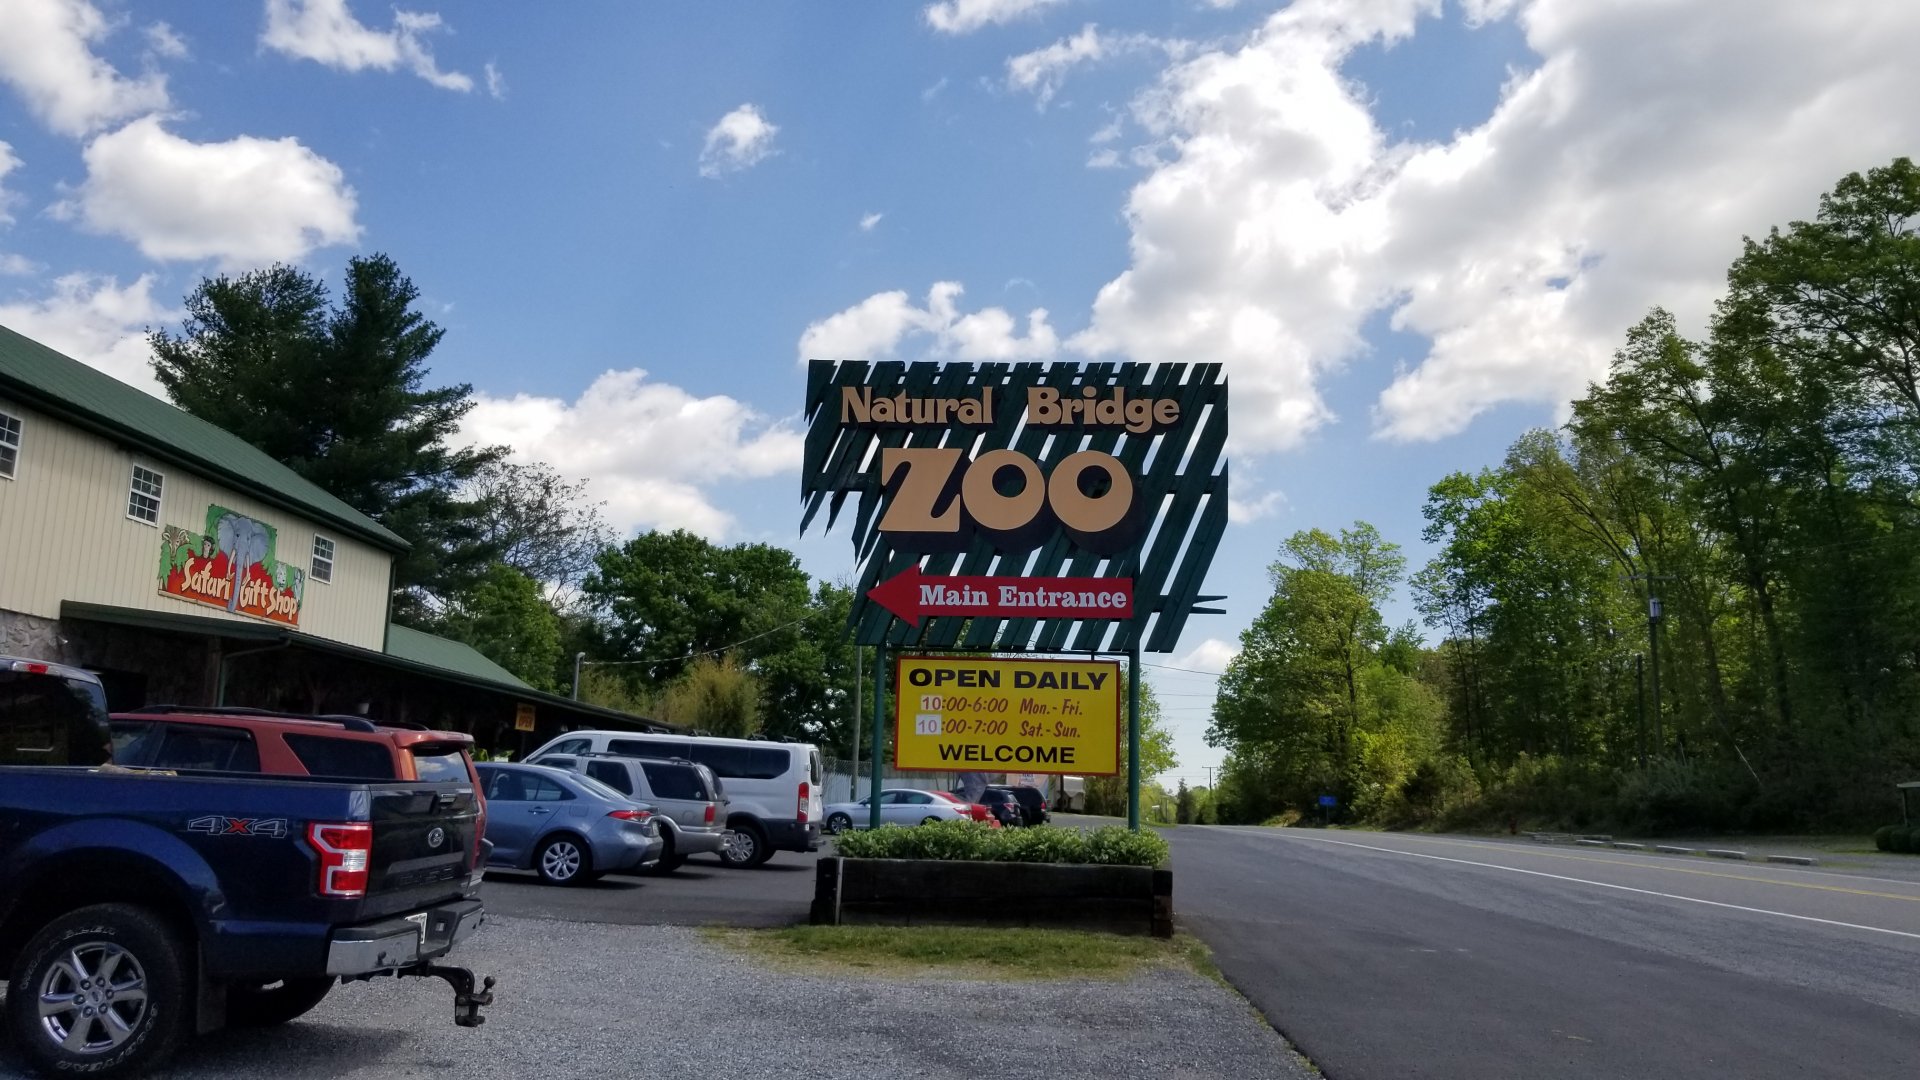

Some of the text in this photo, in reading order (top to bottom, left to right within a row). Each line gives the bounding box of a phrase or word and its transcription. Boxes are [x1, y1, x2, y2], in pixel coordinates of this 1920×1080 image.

[841, 386, 1180, 433] Natural Bridge
[878, 447, 1133, 533] ZOO
[181, 557, 298, 620] Safari Gift Shop
[919, 584, 1127, 609] Main Entrance
[908, 668, 1109, 691] OPEN DAILY
[922, 696, 1009, 713] 10:00-6:00
[918, 719, 1009, 736] 10:00-7:00
[938, 743, 1075, 764] WELCOME
